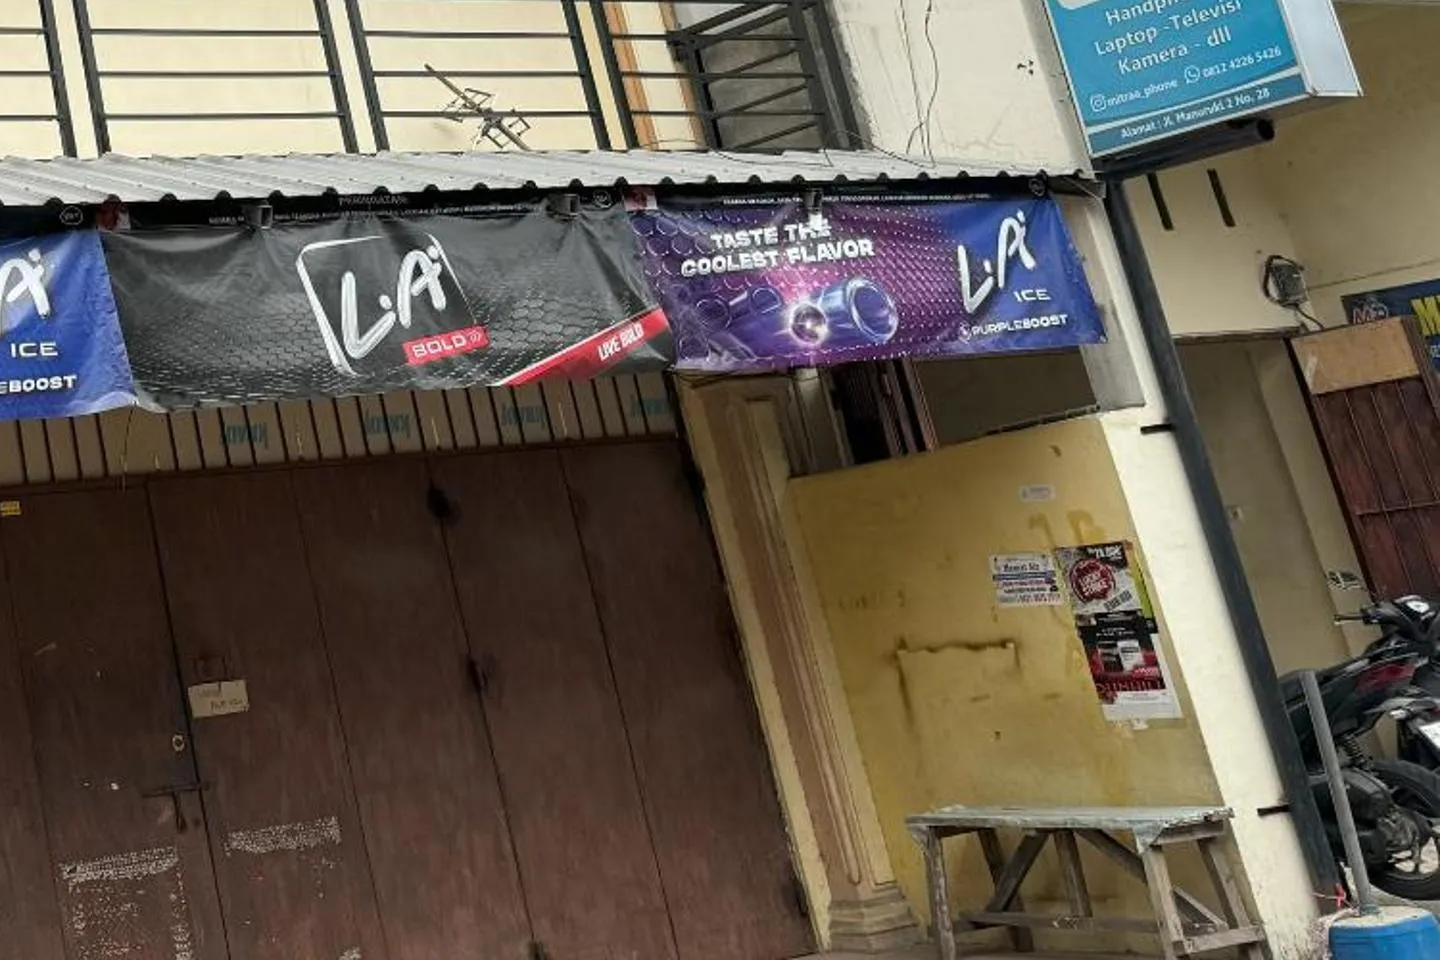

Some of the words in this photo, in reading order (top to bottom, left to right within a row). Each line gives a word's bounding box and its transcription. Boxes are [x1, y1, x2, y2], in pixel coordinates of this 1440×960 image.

[1095, 26, 1157, 56] Laptop
[1118, 43, 1188, 75] Kamera
[1207, 25, 1232, 48] dll
[711, 226, 778, 249] TASTE
[784, 218, 831, 240] THE
[680, 251, 779, 277] COOLEST
[786, 238, 875, 264] FLAVOR
[1014, 289, 1051, 302] ICE
[971, 314, 1068, 335] PURPLEBOOST
[11, 342, 58, 358] ICE
[412, 335, 466, 358] BOLD
[597, 337, 621, 361] LIVE
